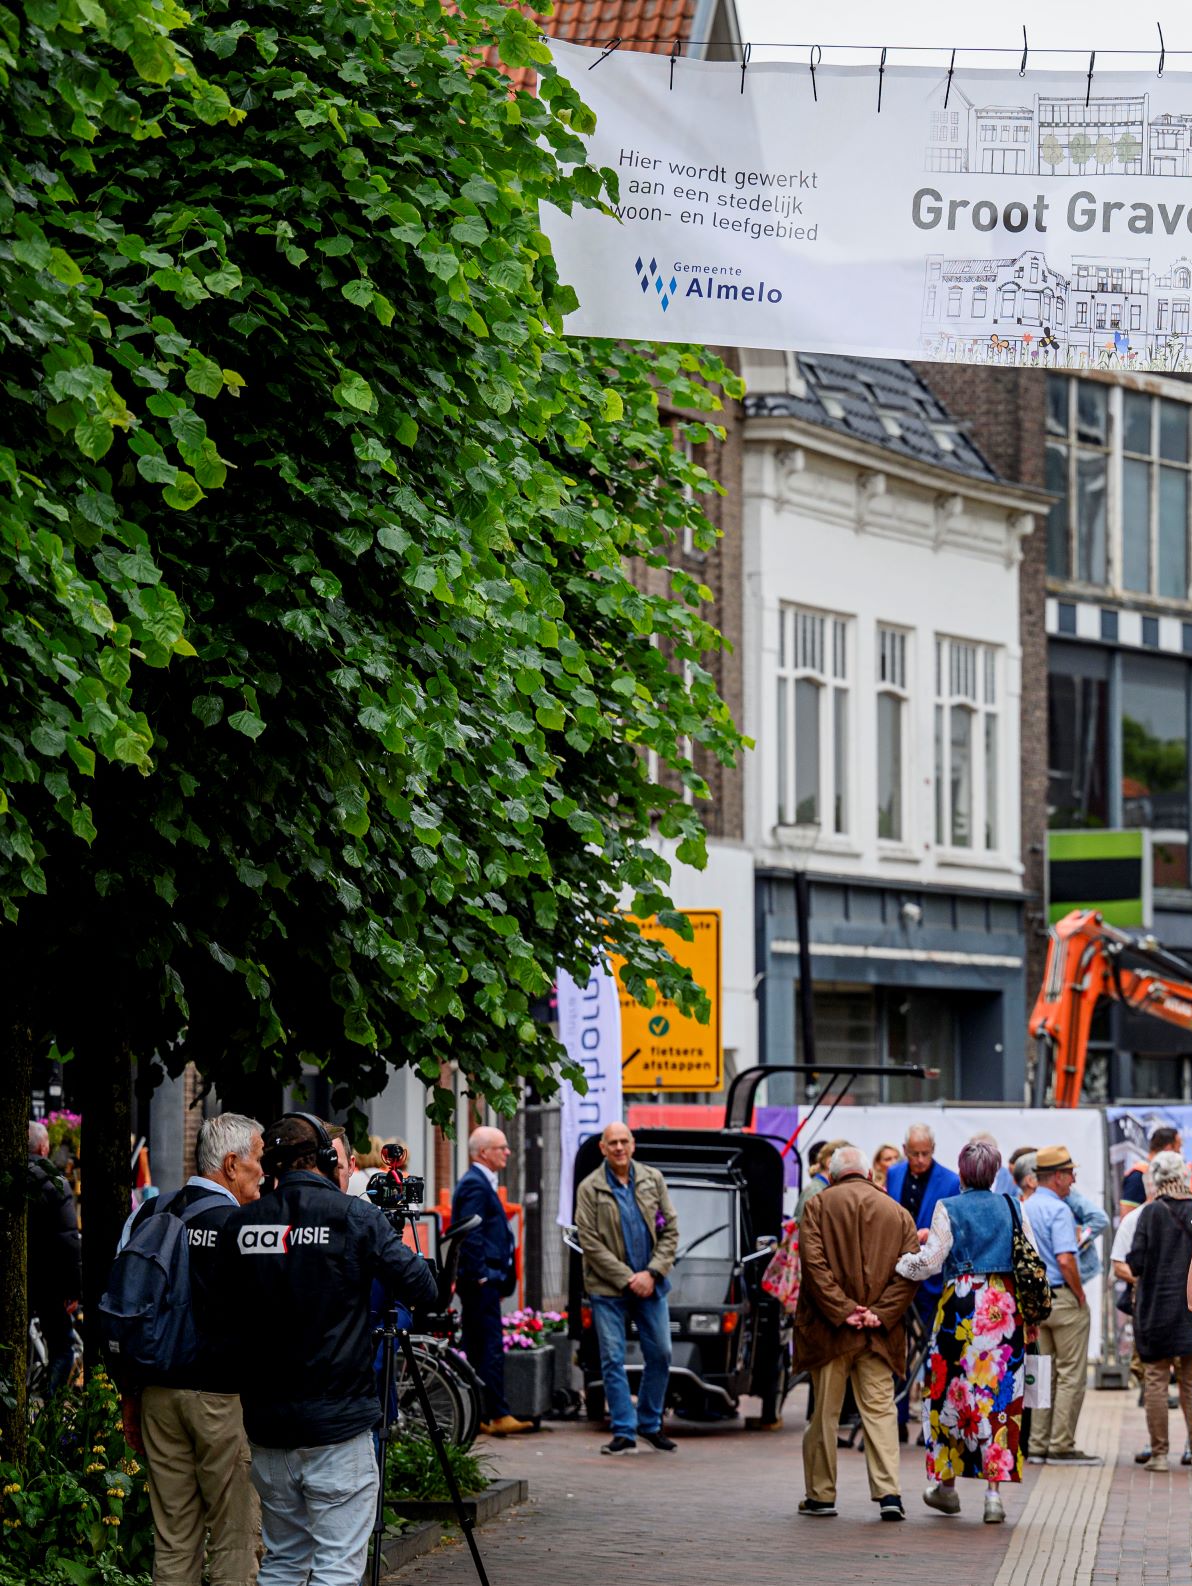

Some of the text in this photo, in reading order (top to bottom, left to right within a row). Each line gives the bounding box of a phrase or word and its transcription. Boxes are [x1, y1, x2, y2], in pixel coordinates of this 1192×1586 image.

[619, 149, 818, 190] Hier wordt gewerkt
[628, 180, 803, 218] aan een stedelijk
[911, 187, 1049, 233] Groot
[610, 205, 818, 241] woon- en leefgebied
[673, 261, 742, 276] Gemeente
[685, 277, 783, 304] Almelo
[651, 1046, 703, 1057] fietsers
[643, 1061, 712, 1072] afstappen
[187, 1229, 218, 1247] ISIE
[289, 1226, 330, 1246] VISIE
